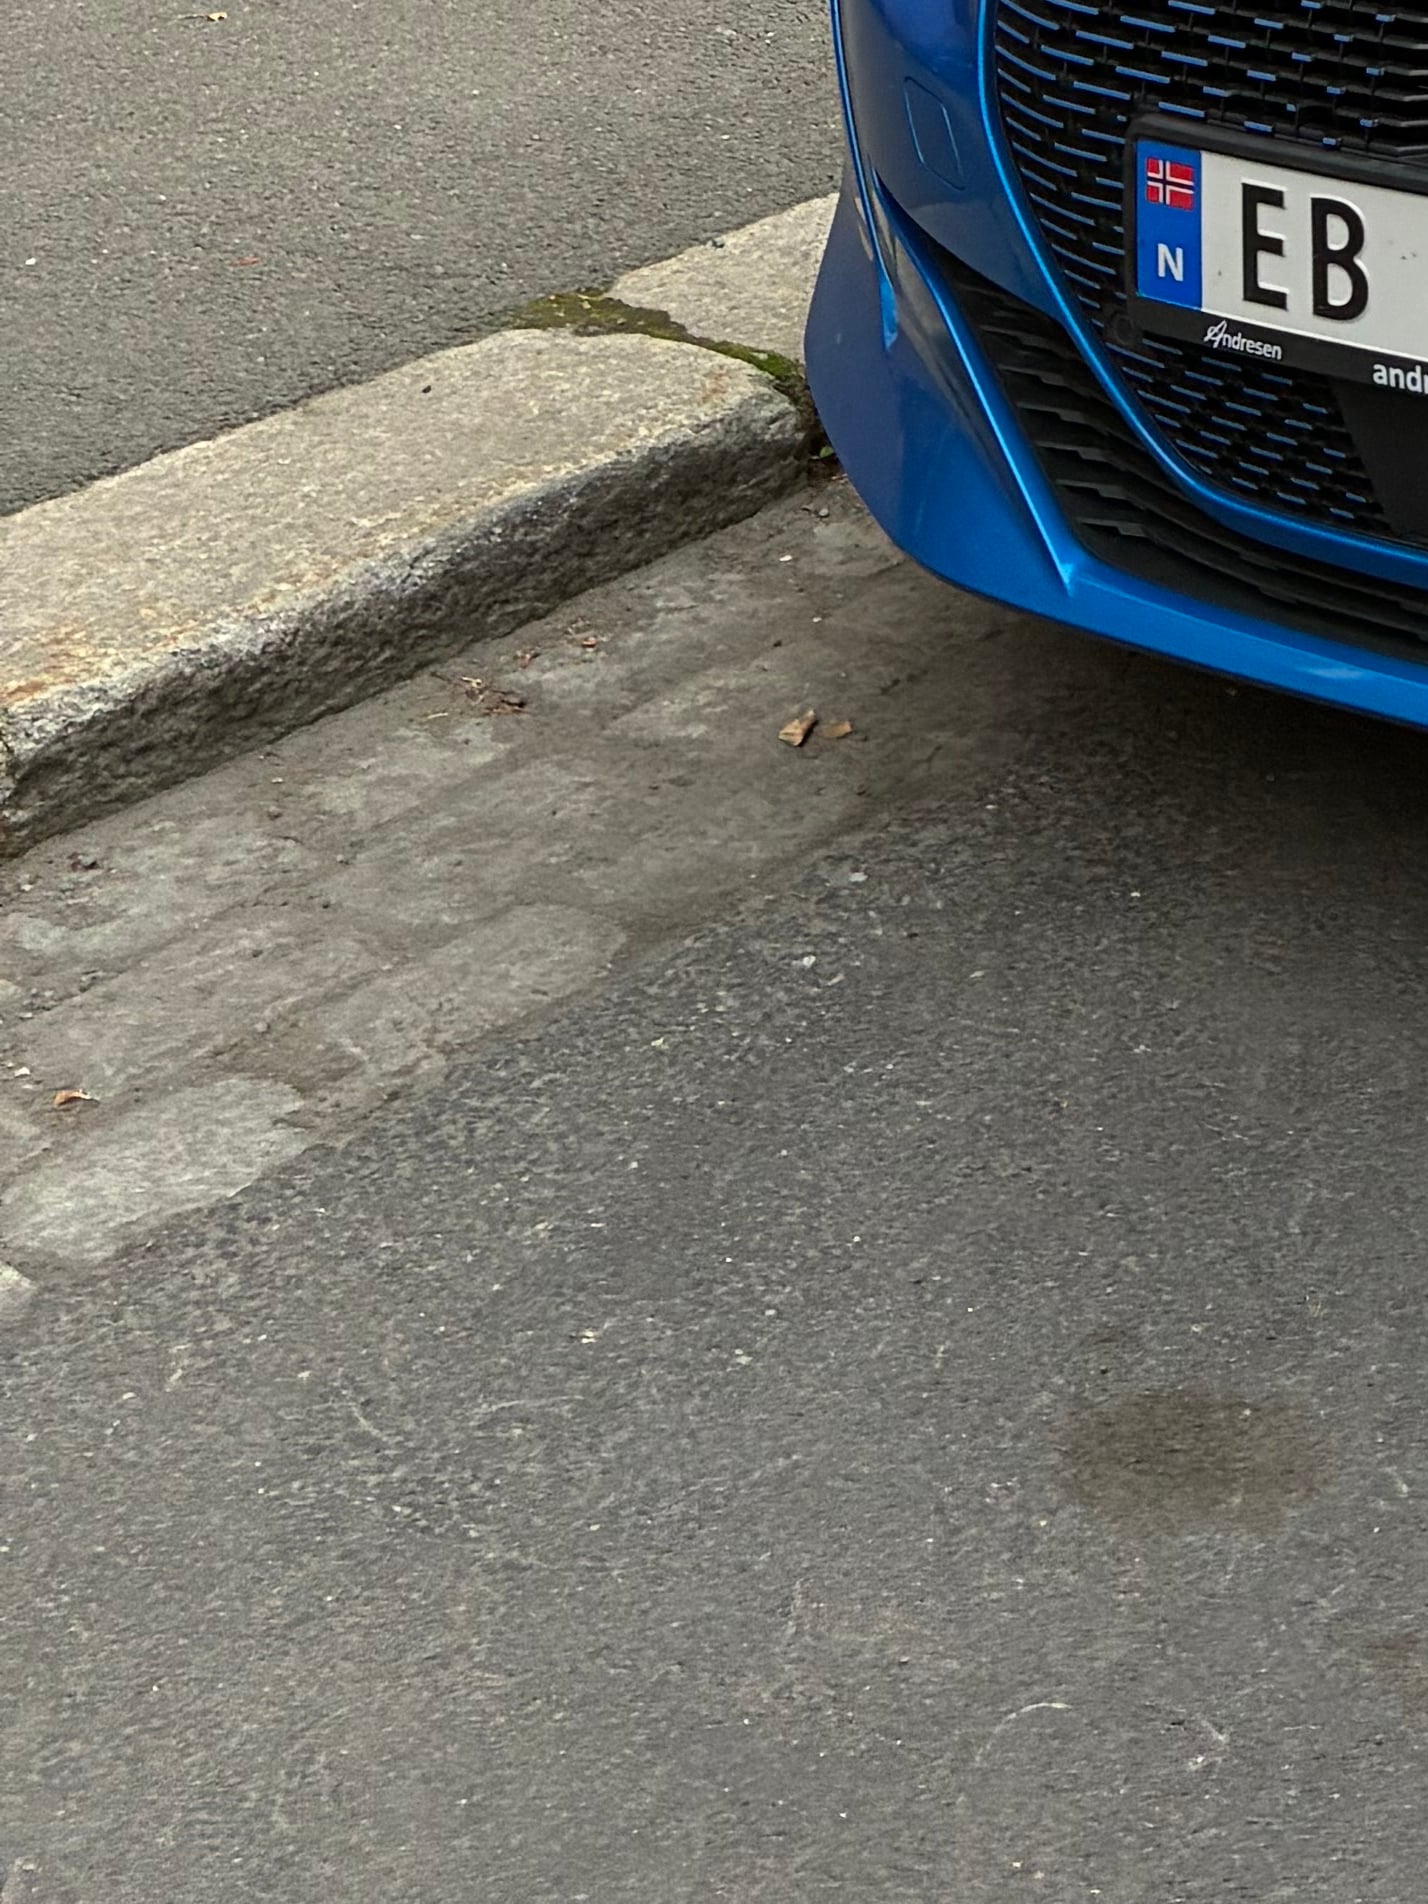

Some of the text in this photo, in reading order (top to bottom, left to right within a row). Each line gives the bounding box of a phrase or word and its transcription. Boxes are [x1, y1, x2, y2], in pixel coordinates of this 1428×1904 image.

[1157, 243, 1184, 282] N
[1241, 180, 1369, 320] EB
[1203, 320, 1283, 361] Andresen
